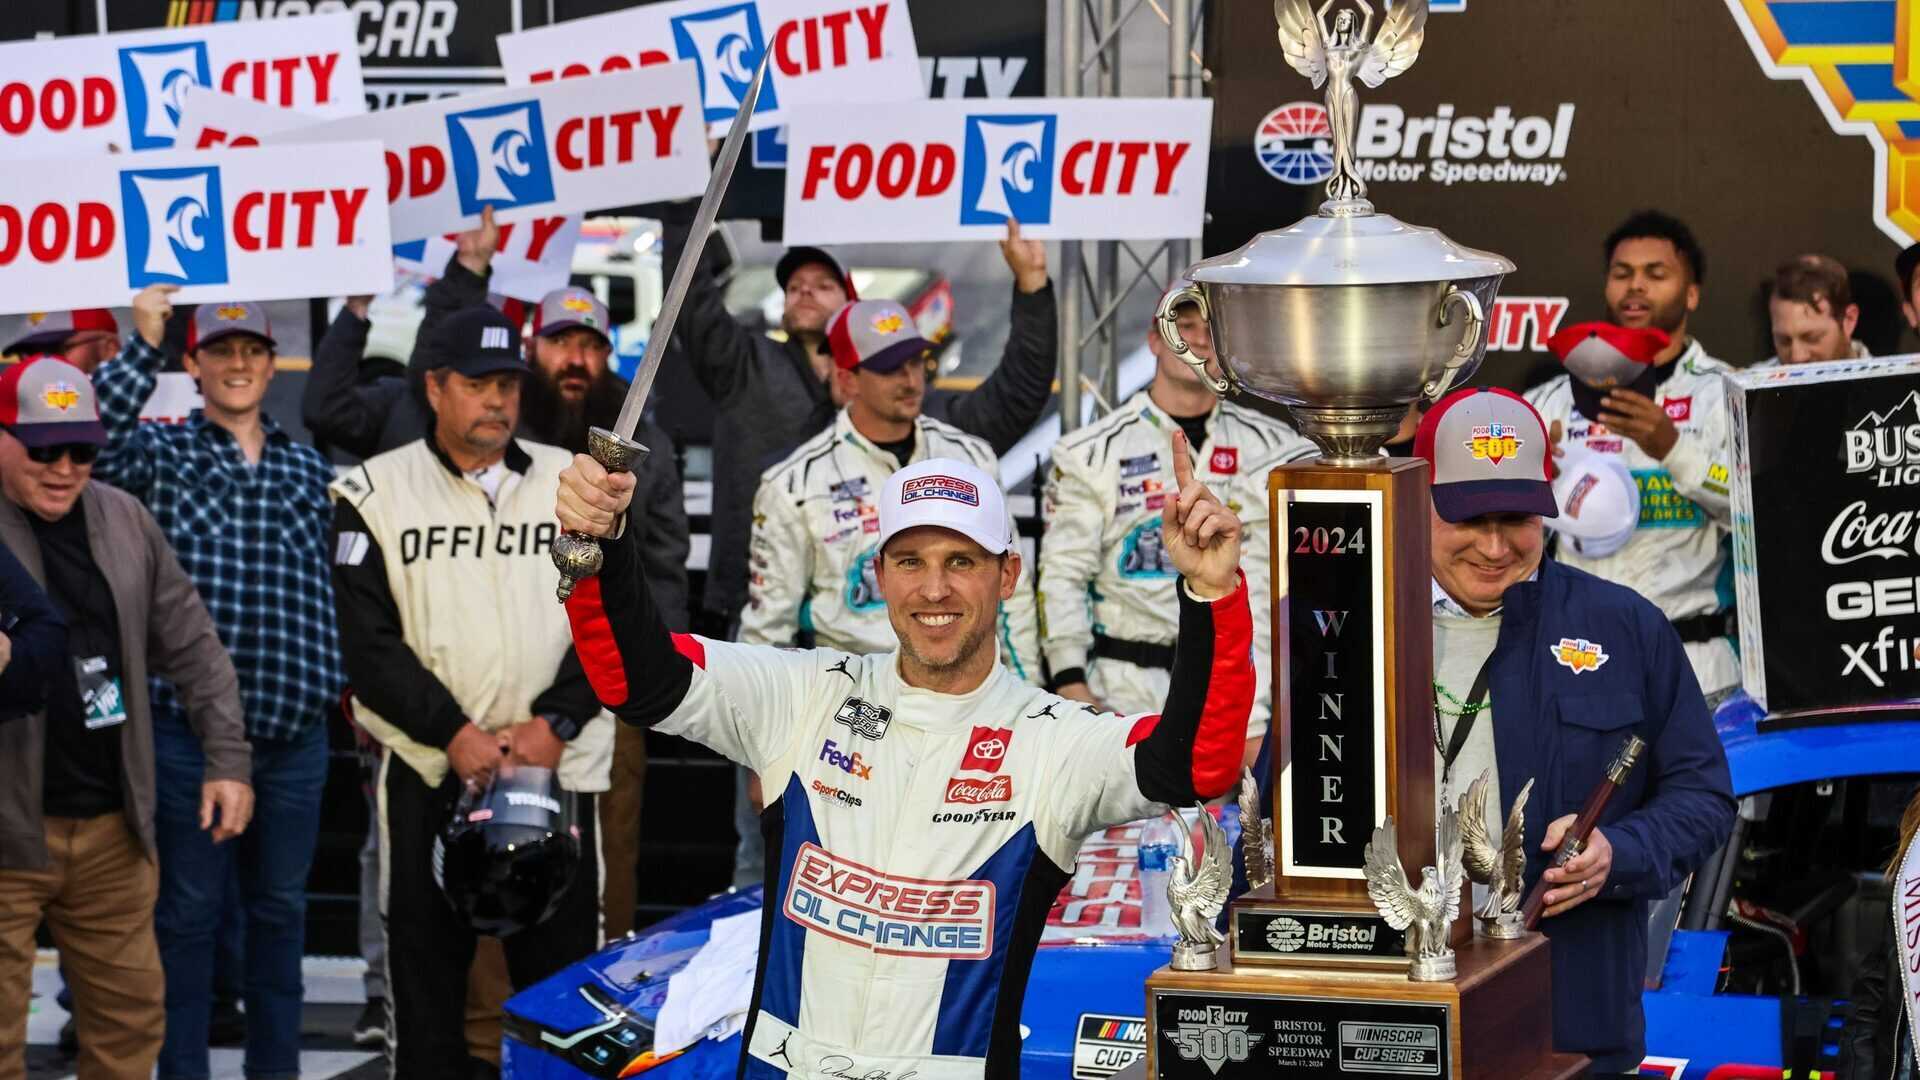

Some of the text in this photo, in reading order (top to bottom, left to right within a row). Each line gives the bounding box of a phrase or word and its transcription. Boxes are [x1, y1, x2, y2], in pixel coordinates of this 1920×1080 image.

[240, 0, 458, 57] CAR
[775, 4, 890, 77] CITY
[555, 105, 683, 172] CITY
[1356, 103, 1576, 159] Bristol
[802, 143, 956, 200] FOOD
[1060, 140, 1191, 195] CITY
[1356, 158, 1562, 186] Motor Speedway
[233, 188, 369, 252] CITY
[1488, 303, 1563, 345] ITY
[1472, 437, 1517, 458] 500
[905, 488, 977, 502] OIL CHANGE
[906, 476, 975, 493] EXPRESS
[400, 522, 557, 566] OFFICIA
[1293, 527, 1366, 555] 2024
[1821, 500, 1920, 565] Coca
[1826, 576, 1920, 621] GE
[1311, 610, 1350, 844] WINNER
[819, 739, 873, 780] FedEx
[948, 777, 1006, 802] Coca-Cola
[800, 855, 983, 916] EXPRESS
[792, 888, 982, 949] OIL CHANGE
[1307, 923, 1376, 943] Bristol
[1306, 941, 1373, 951] Motor Speedway
[1178, 1009, 1248, 1023] FOOD CITY
[1274, 1020, 1326, 1032] BRISTOL
[1178, 1027, 1249, 1061] 500
[1278, 1034, 1323, 1045] MOTOR
[1371, 1029, 1423, 1043] NASCAR
[1095, 1049, 1132, 1067] CUP
[1268, 1046, 1332, 1058] SPEEDWAY
[1354, 1048, 1425, 1063] CUP SERIES
